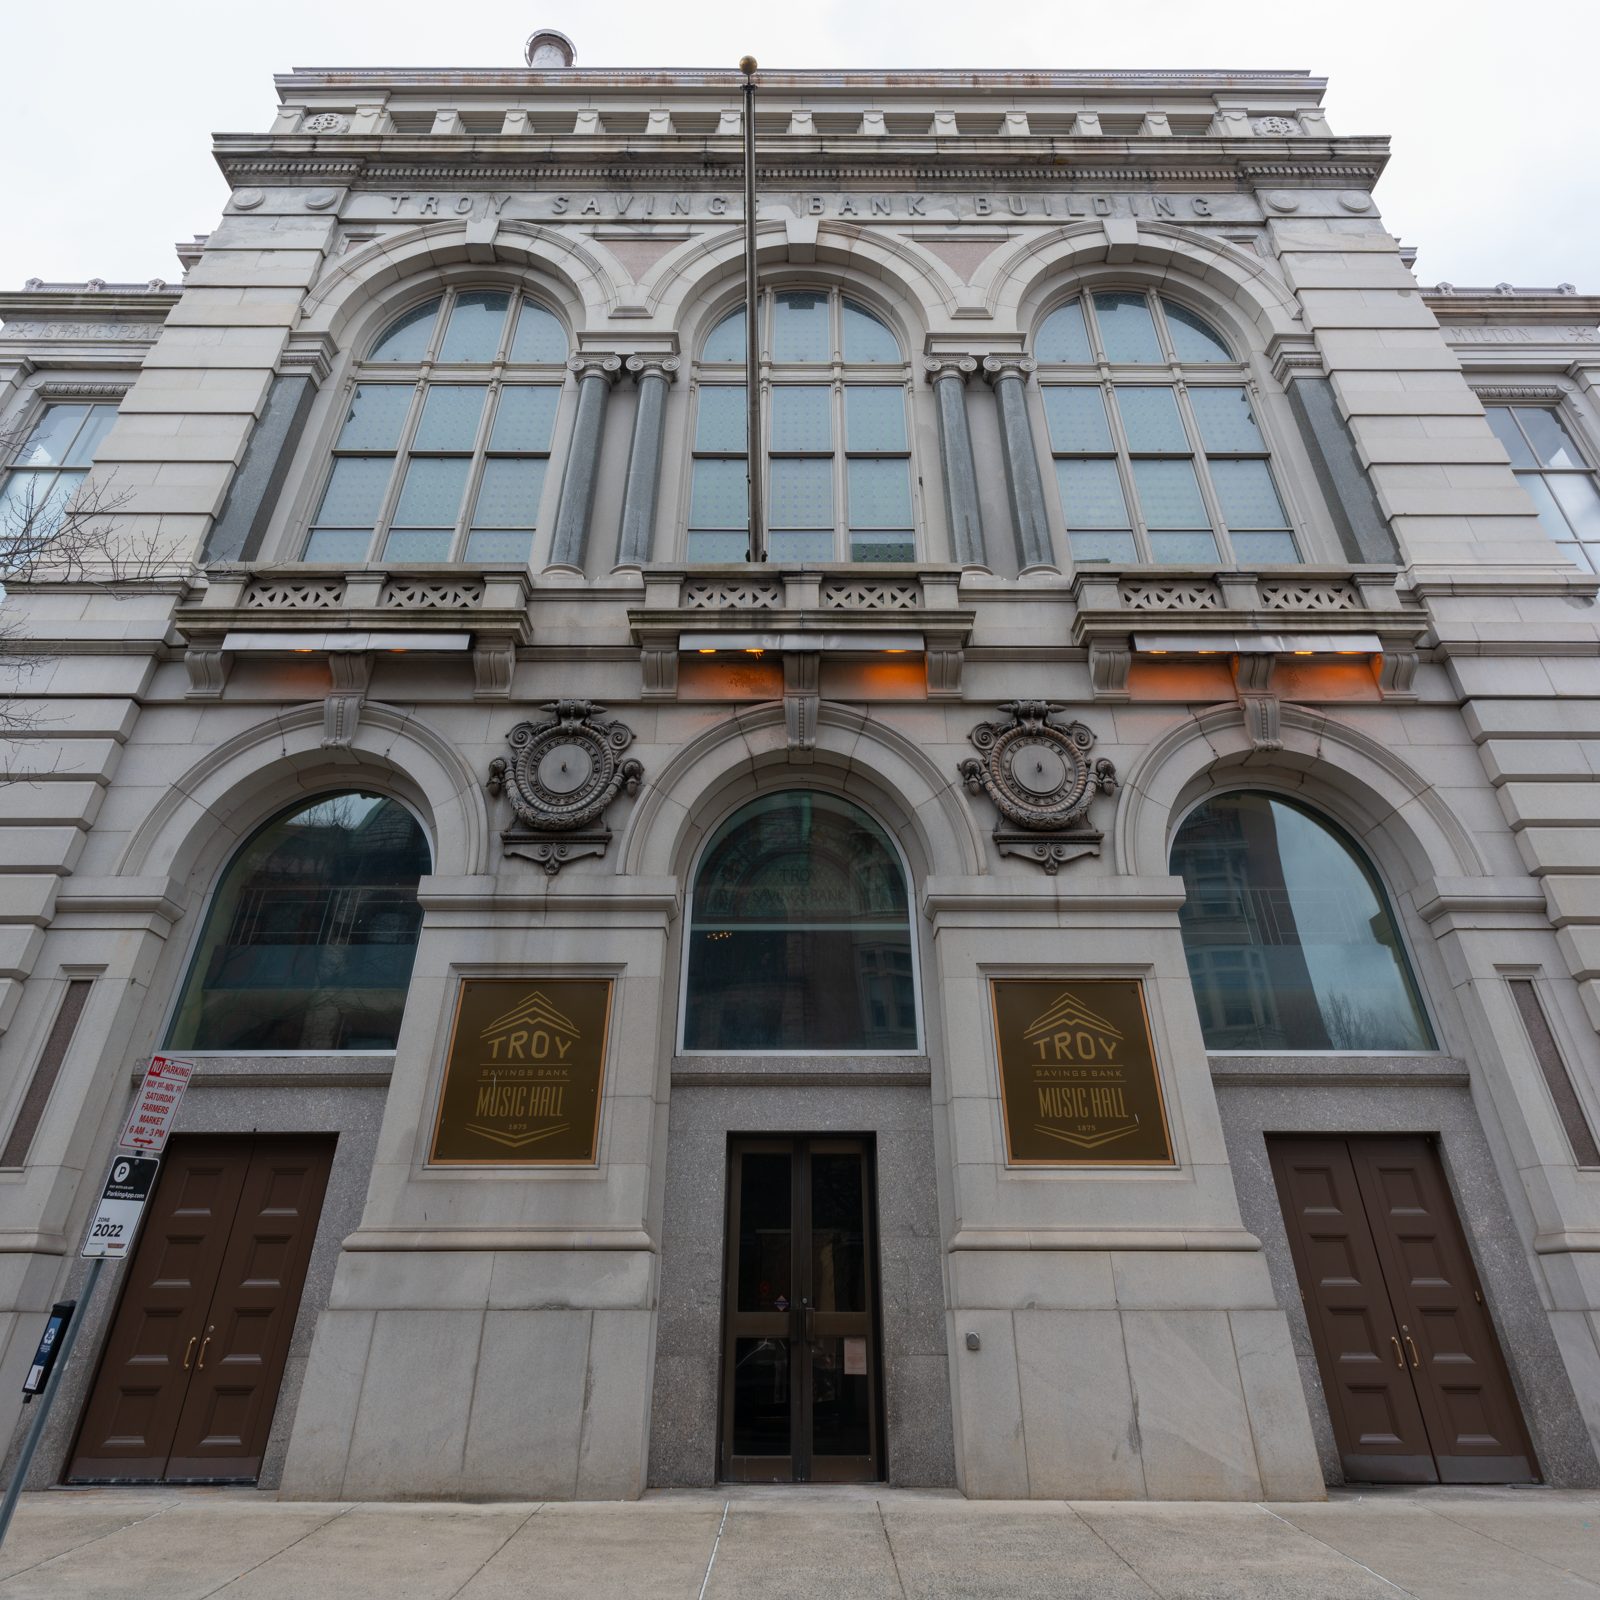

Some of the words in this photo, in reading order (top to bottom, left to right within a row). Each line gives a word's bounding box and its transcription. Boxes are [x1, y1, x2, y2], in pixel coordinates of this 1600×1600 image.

[391, 195, 512, 215] TROY
[807, 195, 927, 217] BANK
[973, 195, 1213, 218] BUILDING
[1449, 327, 1532, 342] MILTON
[487, 1030, 573, 1059] TROY
[1033, 1031, 1117, 1060] TROY
[151, 1060, 163, 1074] NO
[163, 1063, 190, 1078] PARKING
[481, 1069, 533, 1077] SAVINGS
[1035, 1069, 1088, 1077] SAVINGS
[1091, 1069, 1123, 1077] BANK
[145, 1091, 176, 1104] SATURDAY
[475, 1086, 527, 1117] MUSIC
[528, 1086, 563, 1117] HALL
[1038, 1087, 1089, 1118] MUSIC
[1091, 1087, 1129, 1118] HALL
[142, 1103, 169, 1114] FARMERS
[139, 1115, 164, 1125] MARKET
[128, 1125, 135, 1134] 6
[133, 1126, 146, 1135] AM
[149, 1128, 155, 1137] 3
[154, 1128, 166, 1138] PM
[106, 1190, 145, 1199] ParkingApp.com
[92, 1223, 124, 1238] 2022
